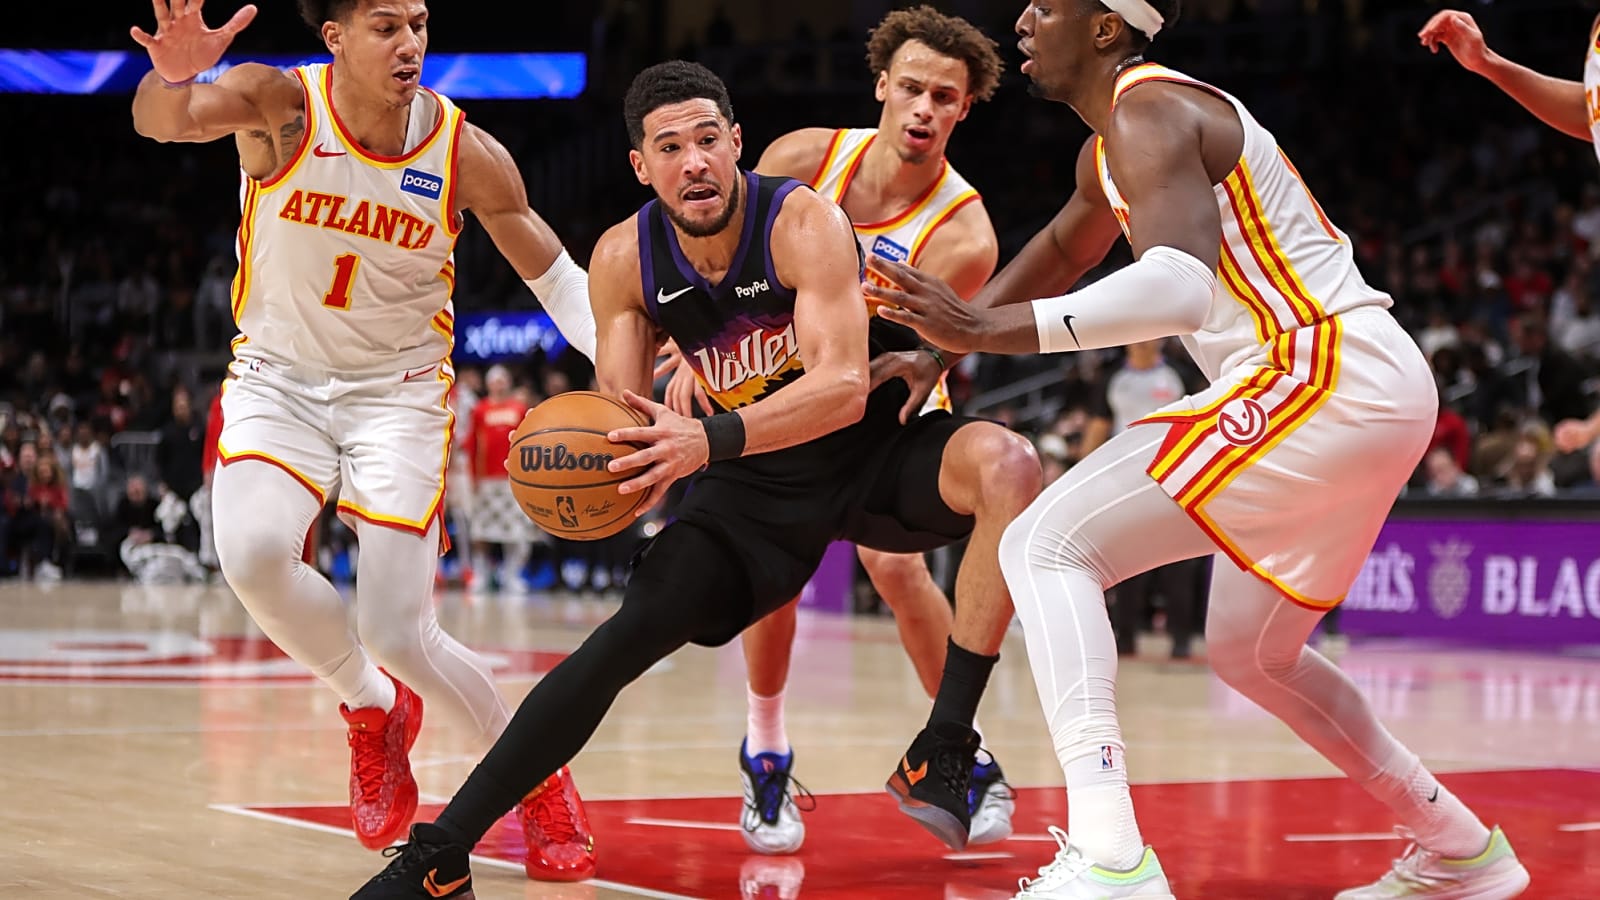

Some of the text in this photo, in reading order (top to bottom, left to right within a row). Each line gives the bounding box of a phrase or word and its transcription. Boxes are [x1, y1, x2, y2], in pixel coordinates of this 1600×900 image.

[403, 174, 440, 192] paze
[279, 189, 436, 250] ATLANTA
[874, 240, 906, 261] paze
[321, 252, 361, 311] 1
[735, 279, 770, 298] PayPal
[520, 442, 614, 473] Wilson
